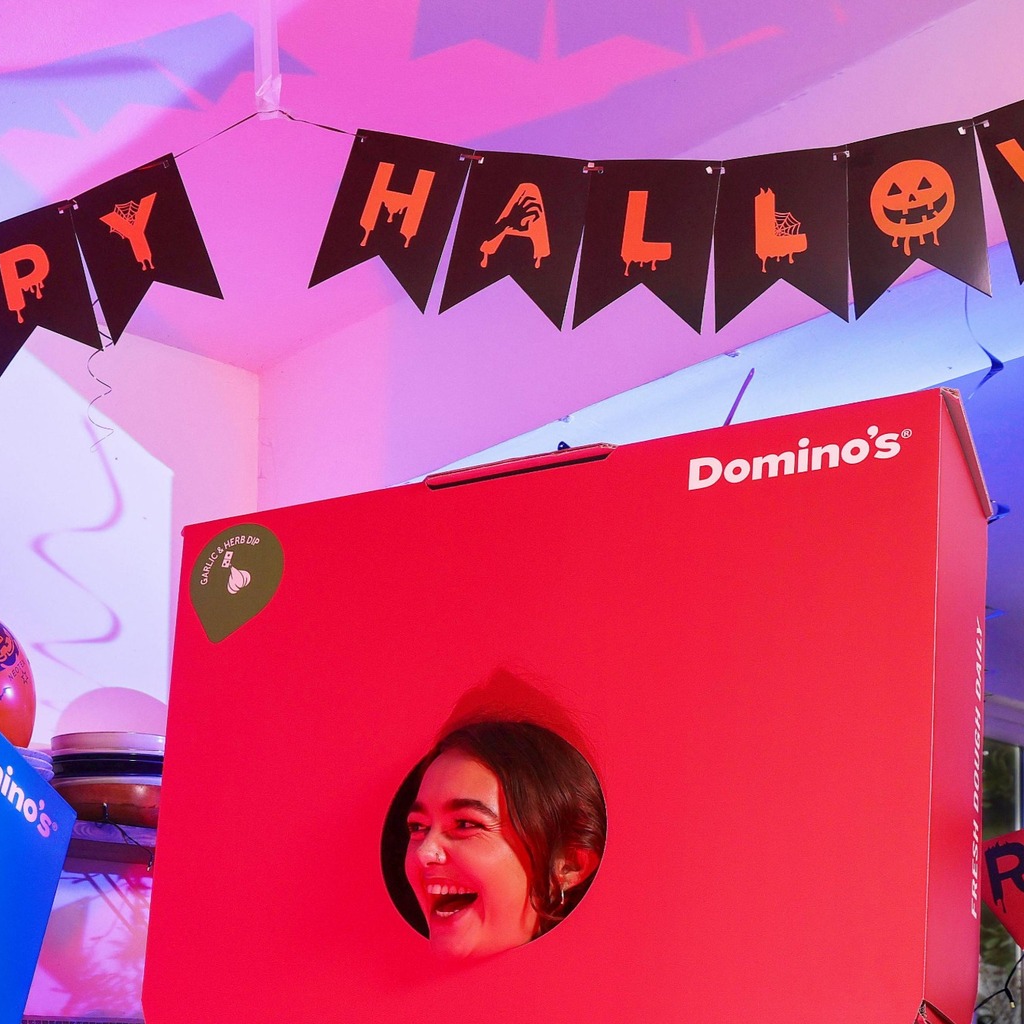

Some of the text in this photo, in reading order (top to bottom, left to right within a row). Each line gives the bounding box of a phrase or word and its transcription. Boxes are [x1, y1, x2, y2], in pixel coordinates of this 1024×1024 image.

[200, 535, 260, 585] GARLIC & HERB DIP
[971, 616, 983, 919] FRESH DOUGH DAILY
